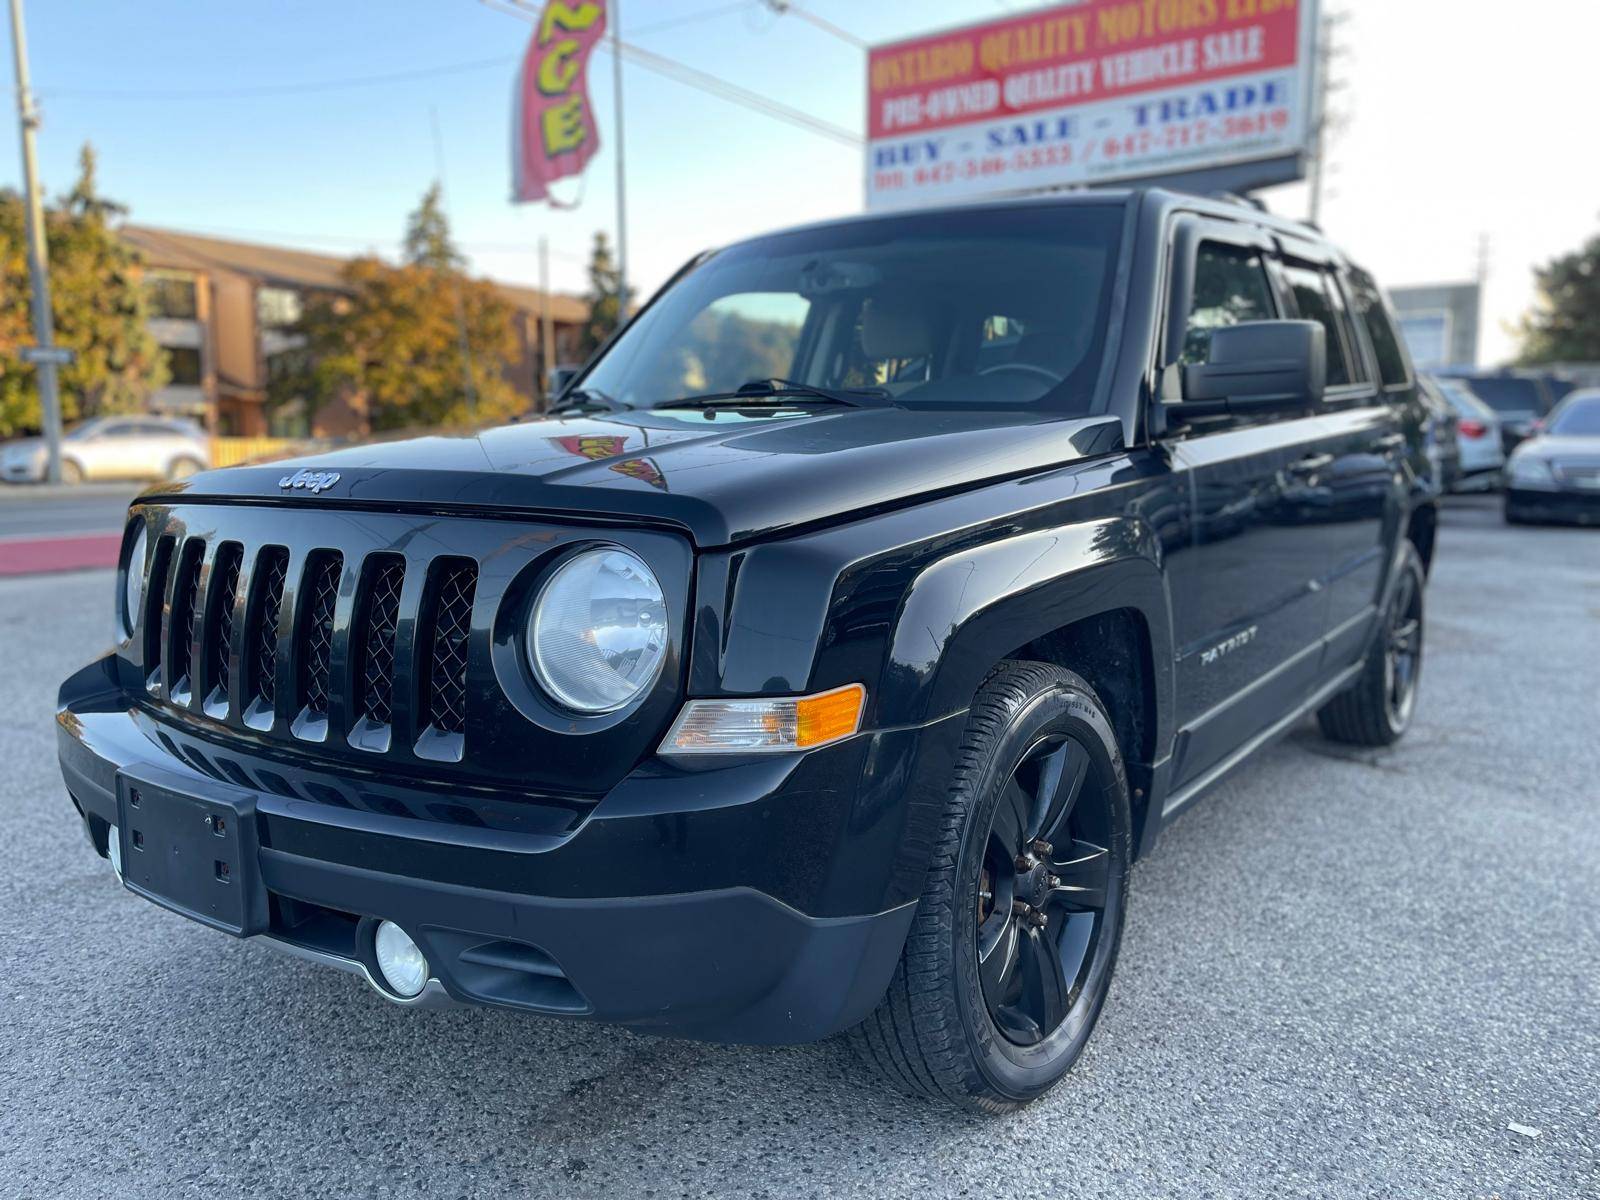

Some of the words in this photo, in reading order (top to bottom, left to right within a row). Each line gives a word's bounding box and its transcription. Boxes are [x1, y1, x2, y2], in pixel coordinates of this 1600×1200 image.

[872, 38, 974, 92] ONTARIO
[980, 13, 1091, 71] QUALITY
[1096, 0, 1218, 45] MOTORS
[881, 79, 1000, 129] PRE-OWNED
[1003, 59, 1095, 110] QUALITY
[1100, 38, 1198, 90] VEHICLE
[1203, 24, 1264, 70] SALE
[874, 138, 944, 169] BUY
[986, 113, 1079, 152] SALE
[1127, 77, 1288, 127] TRADE
[278, 467, 341, 494] Jeep
[1200, 625, 1259, 667] PATRIOT
